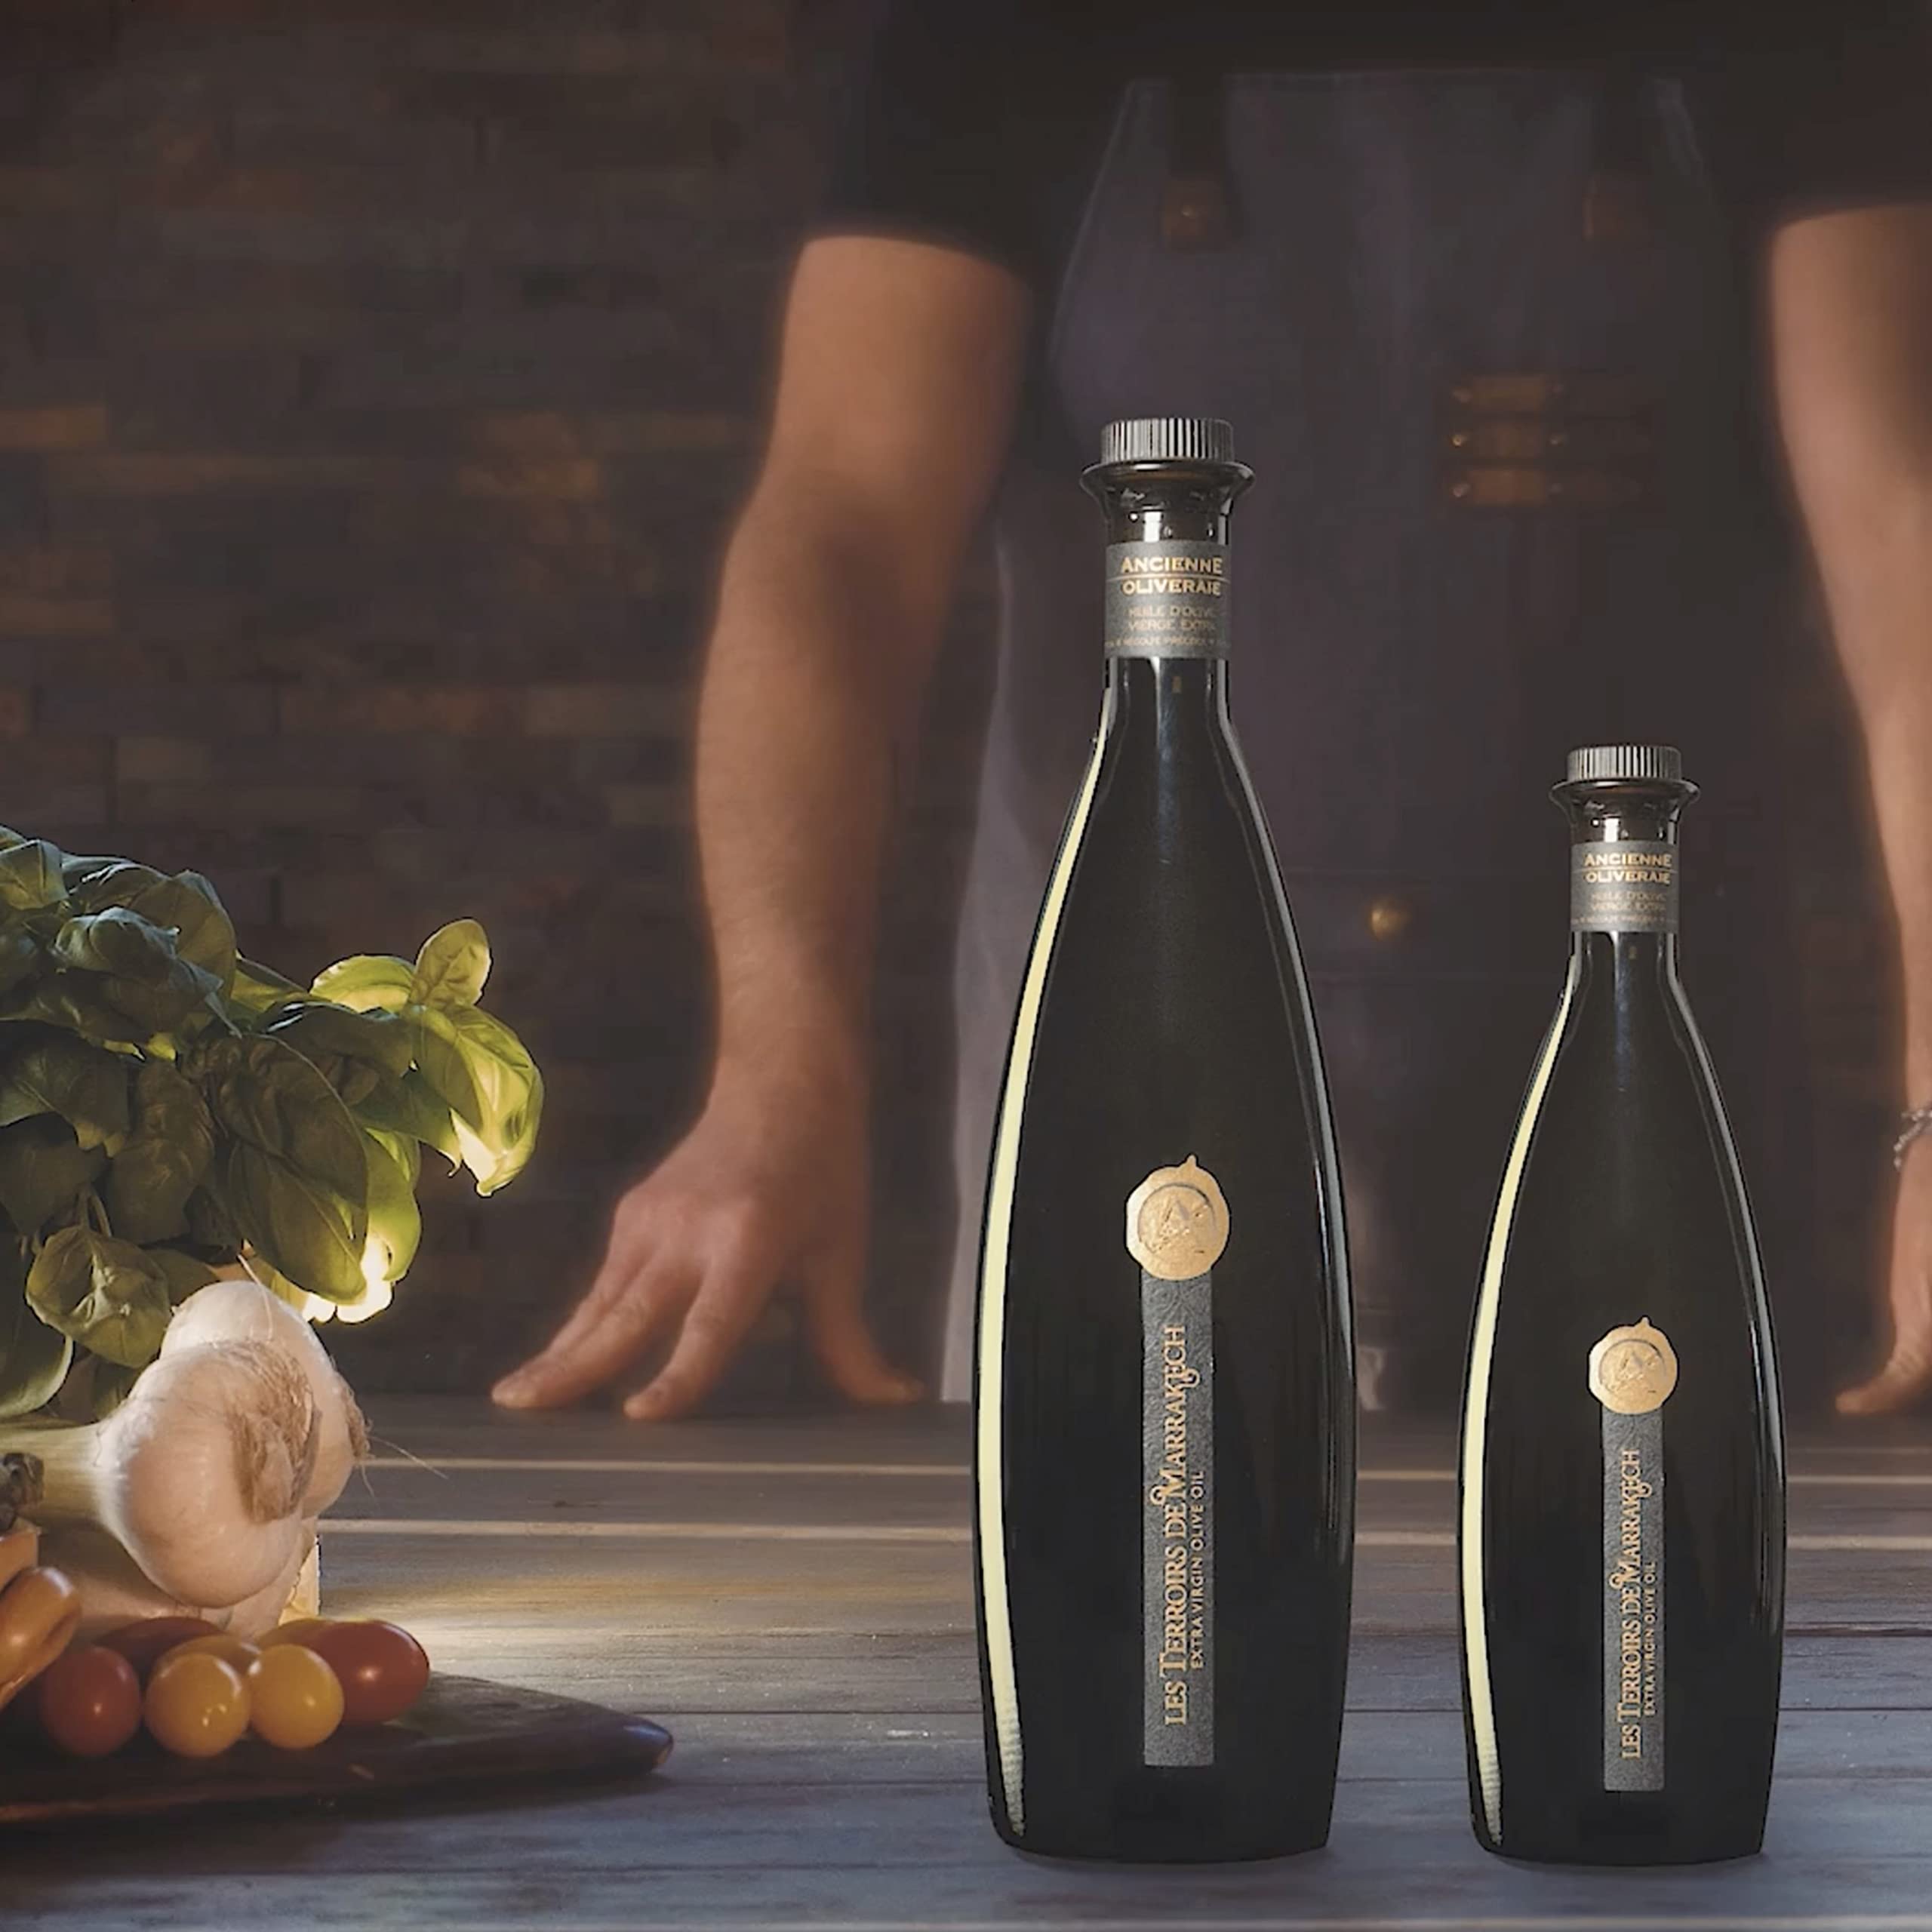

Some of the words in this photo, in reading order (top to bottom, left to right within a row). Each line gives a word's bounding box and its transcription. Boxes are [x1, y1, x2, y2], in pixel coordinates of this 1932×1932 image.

[1121, 555, 1223, 574] ANCIENNE
[1122, 579, 1222, 596] OLIVERAIE
[1585, 853, 1672, 867] ANCIENNE
[1586, 870, 1670, 884] OLIVERAIE
[1149, 1325, 1200, 1506] MARRAKECH
[1190, 1470, 1204, 1498] OIL
[1164, 1503, 1187, 1538] DE
[1190, 1504, 1204, 1551] OLIVE
[1609, 1450, 1653, 1589] MARRAKECH
[1190, 1556, 1204, 1614] VIRGIN
[1644, 1561, 1656, 1584] OIL
[1158, 1545, 1188, 1678] TERROIRS
[1621, 1586, 1641, 1614] DE
[1644, 1588, 1656, 1626] OLIVE
[1190, 1616, 1204, 1669] EXTRA
[1644, 1629, 1656, 1673] VIRGIN
[1617, 1620, 1641, 1723] TERROIRS
[1164, 1681, 1187, 1725] LES
[1644, 1675, 1656, 1716] EXTRA
[1621, 1724, 1641, 1759] LES
